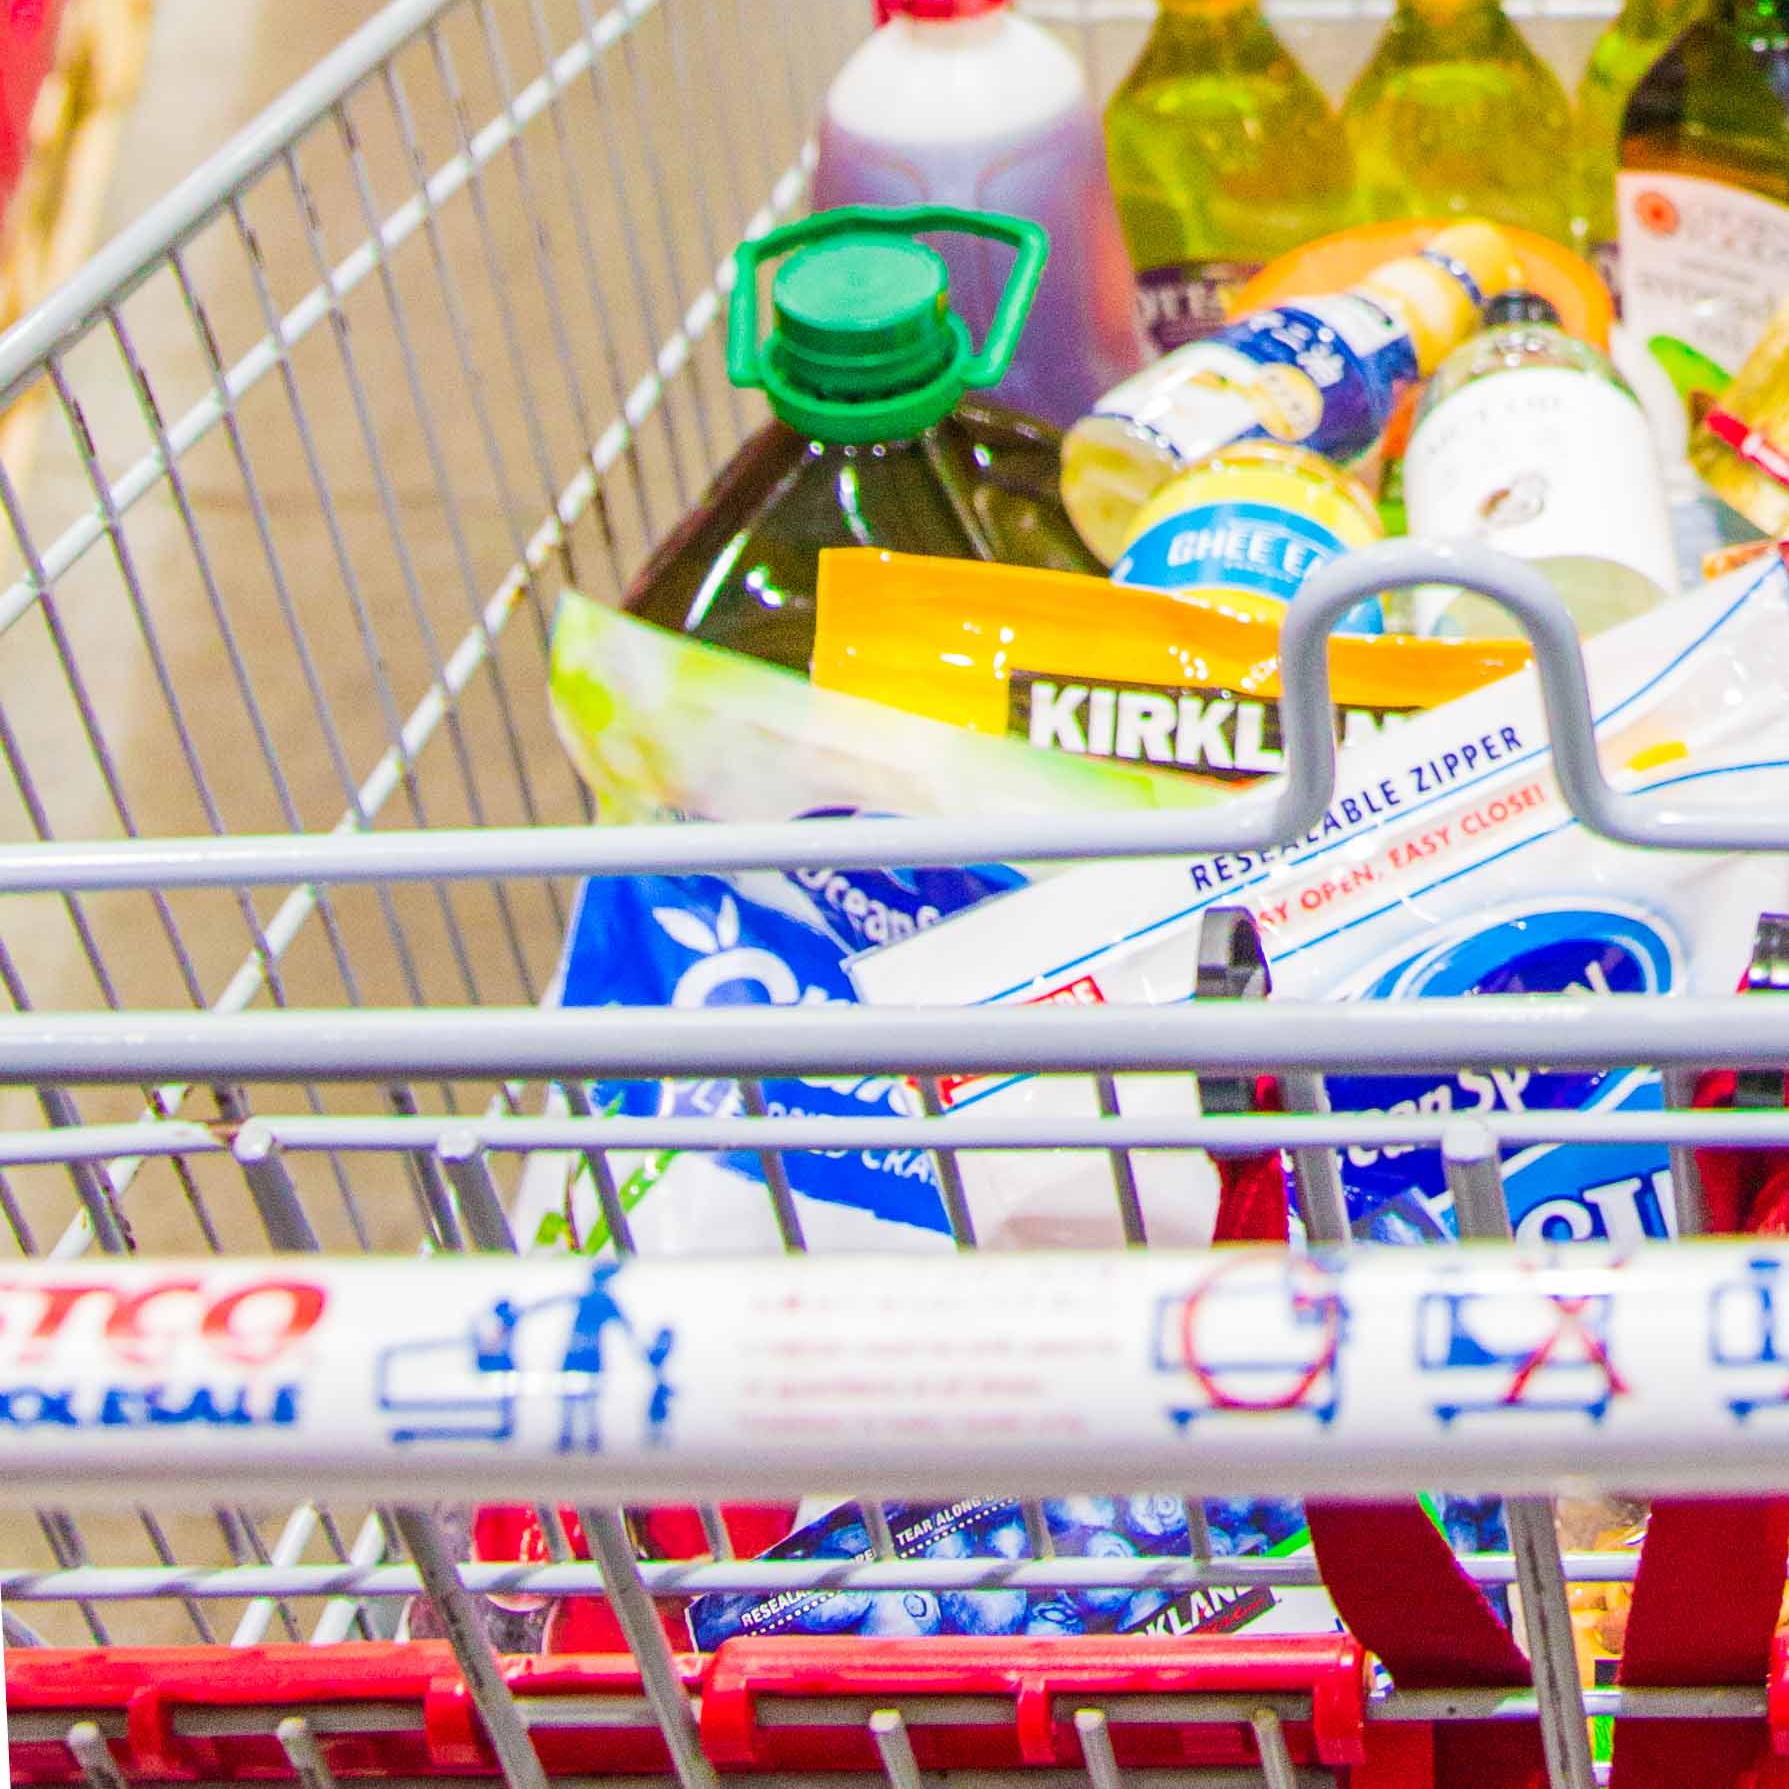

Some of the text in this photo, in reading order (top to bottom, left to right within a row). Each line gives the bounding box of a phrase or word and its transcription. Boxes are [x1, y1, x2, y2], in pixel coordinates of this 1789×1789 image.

[1168, 525, 1274, 568] GHEE
[1409, 725, 1524, 794] ZIPPER
[1391, 826, 1453, 870] EASY
[1460, 783, 1545, 836] CLOSE!
[896, 1495, 983, 1546] TEAR ALONG
